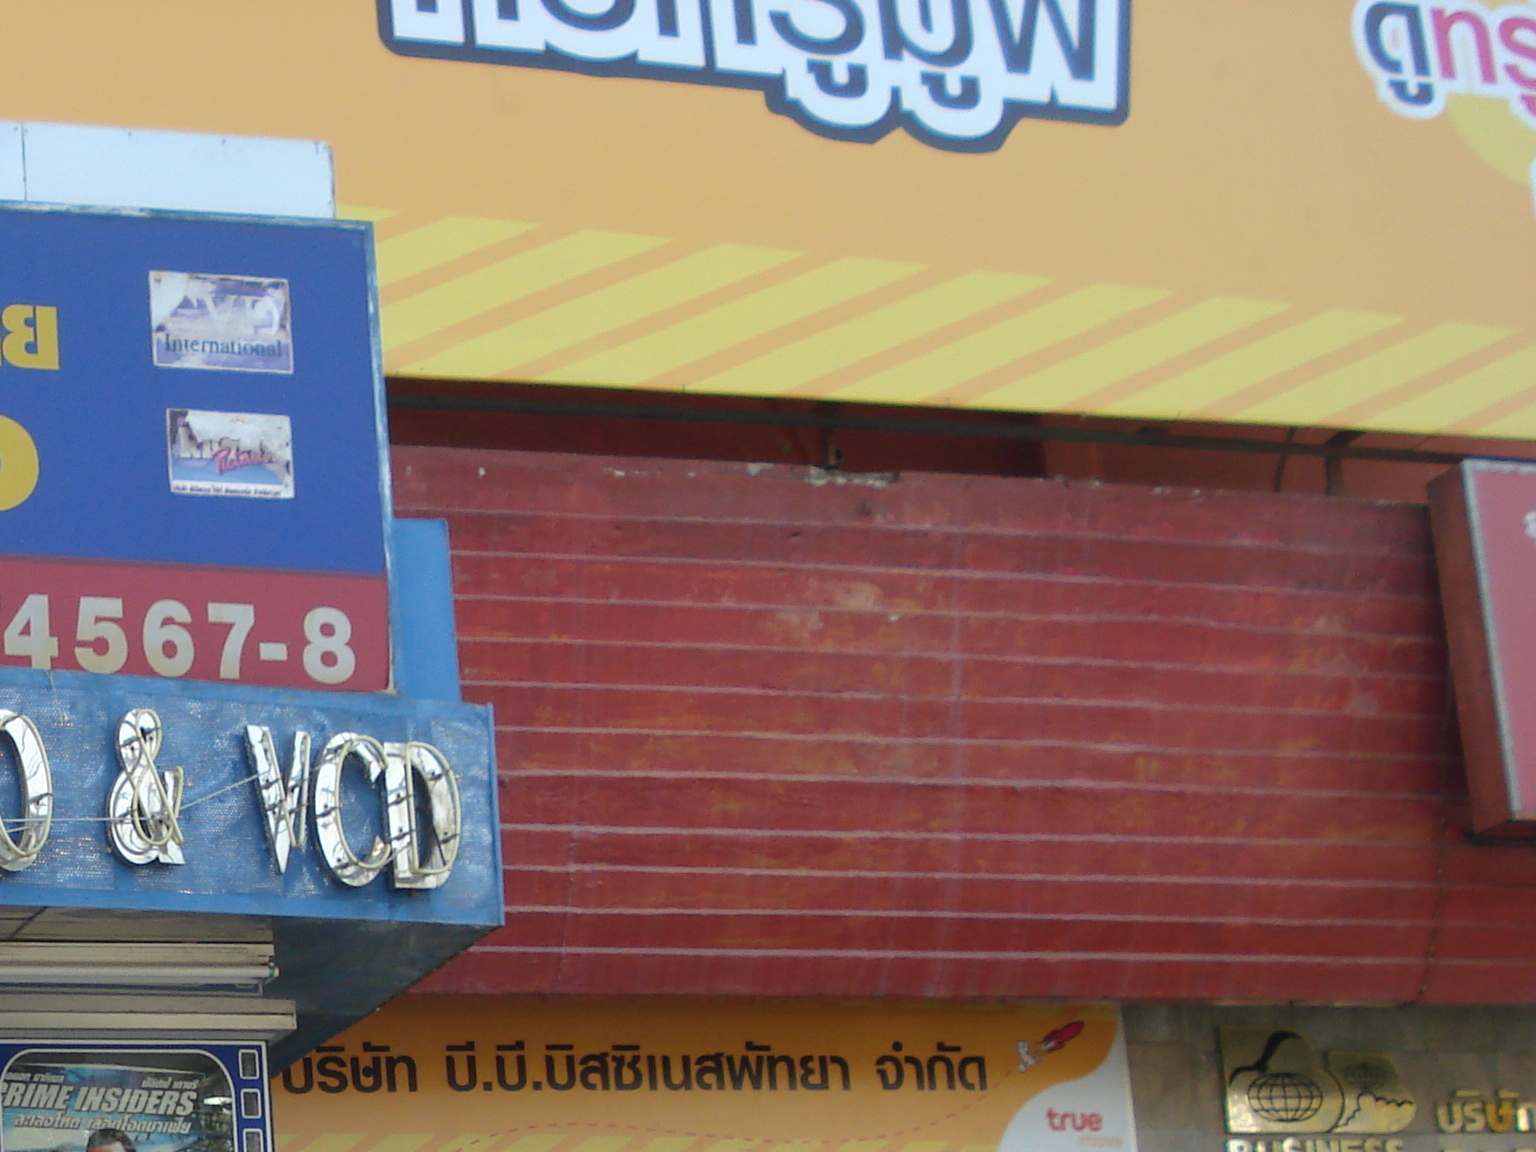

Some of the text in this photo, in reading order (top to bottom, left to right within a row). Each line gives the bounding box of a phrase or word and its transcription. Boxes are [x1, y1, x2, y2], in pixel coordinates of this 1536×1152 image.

[164, 333, 283, 358] International
[108, 707, 186, 867] &
[245, 723, 463, 891] VCD
[281, 1042, 417, 1094] บริษัท
[875, 1041, 988, 1091] จำกัด
[74, 1087, 198, 1116] INSIDERS
[1046, 1107, 1103, 1132] true
